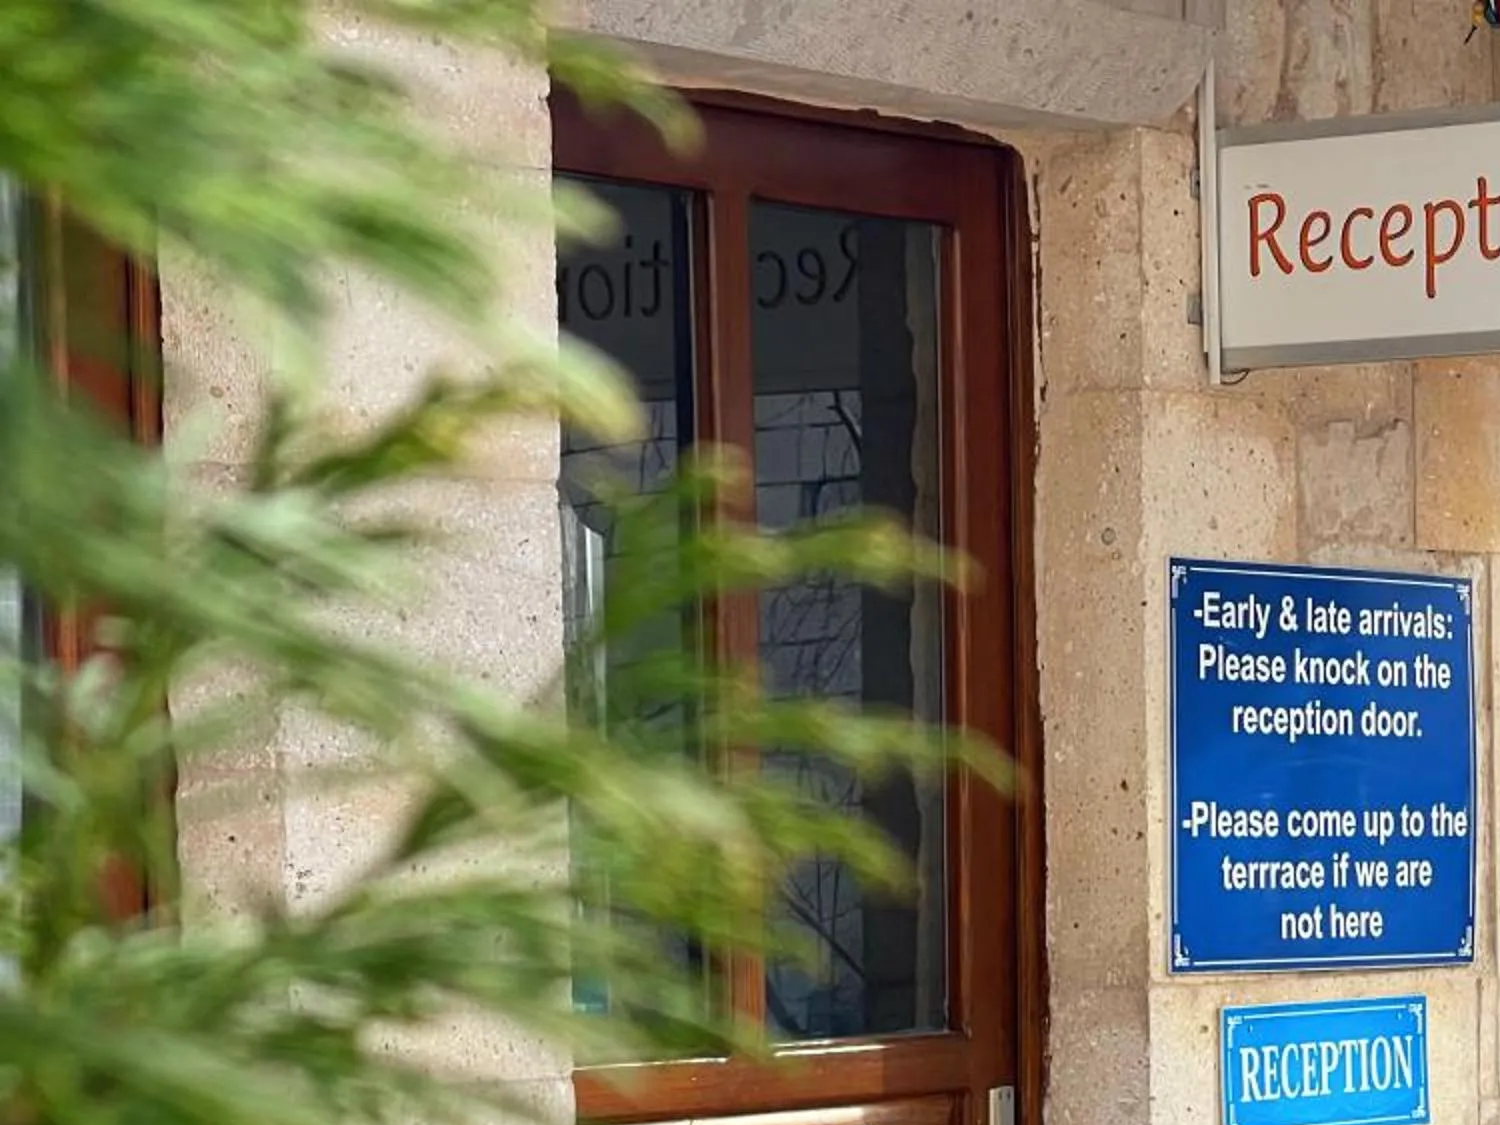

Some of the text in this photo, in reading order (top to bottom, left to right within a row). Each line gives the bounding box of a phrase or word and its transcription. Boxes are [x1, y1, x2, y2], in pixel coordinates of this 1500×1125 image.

[1193, 591, 1454, 640] -Early & late arrivals:
[1199, 643, 1452, 689] Please knock on the
[1233, 701, 1423, 743] reception door.
[1182, 801, 1468, 846] -Please come up to the
[1221, 853, 1433, 890] terrrace if we are
[1281, 903, 1383, 939] not here
[1240, 1034, 1413, 1103] RECEPTION
